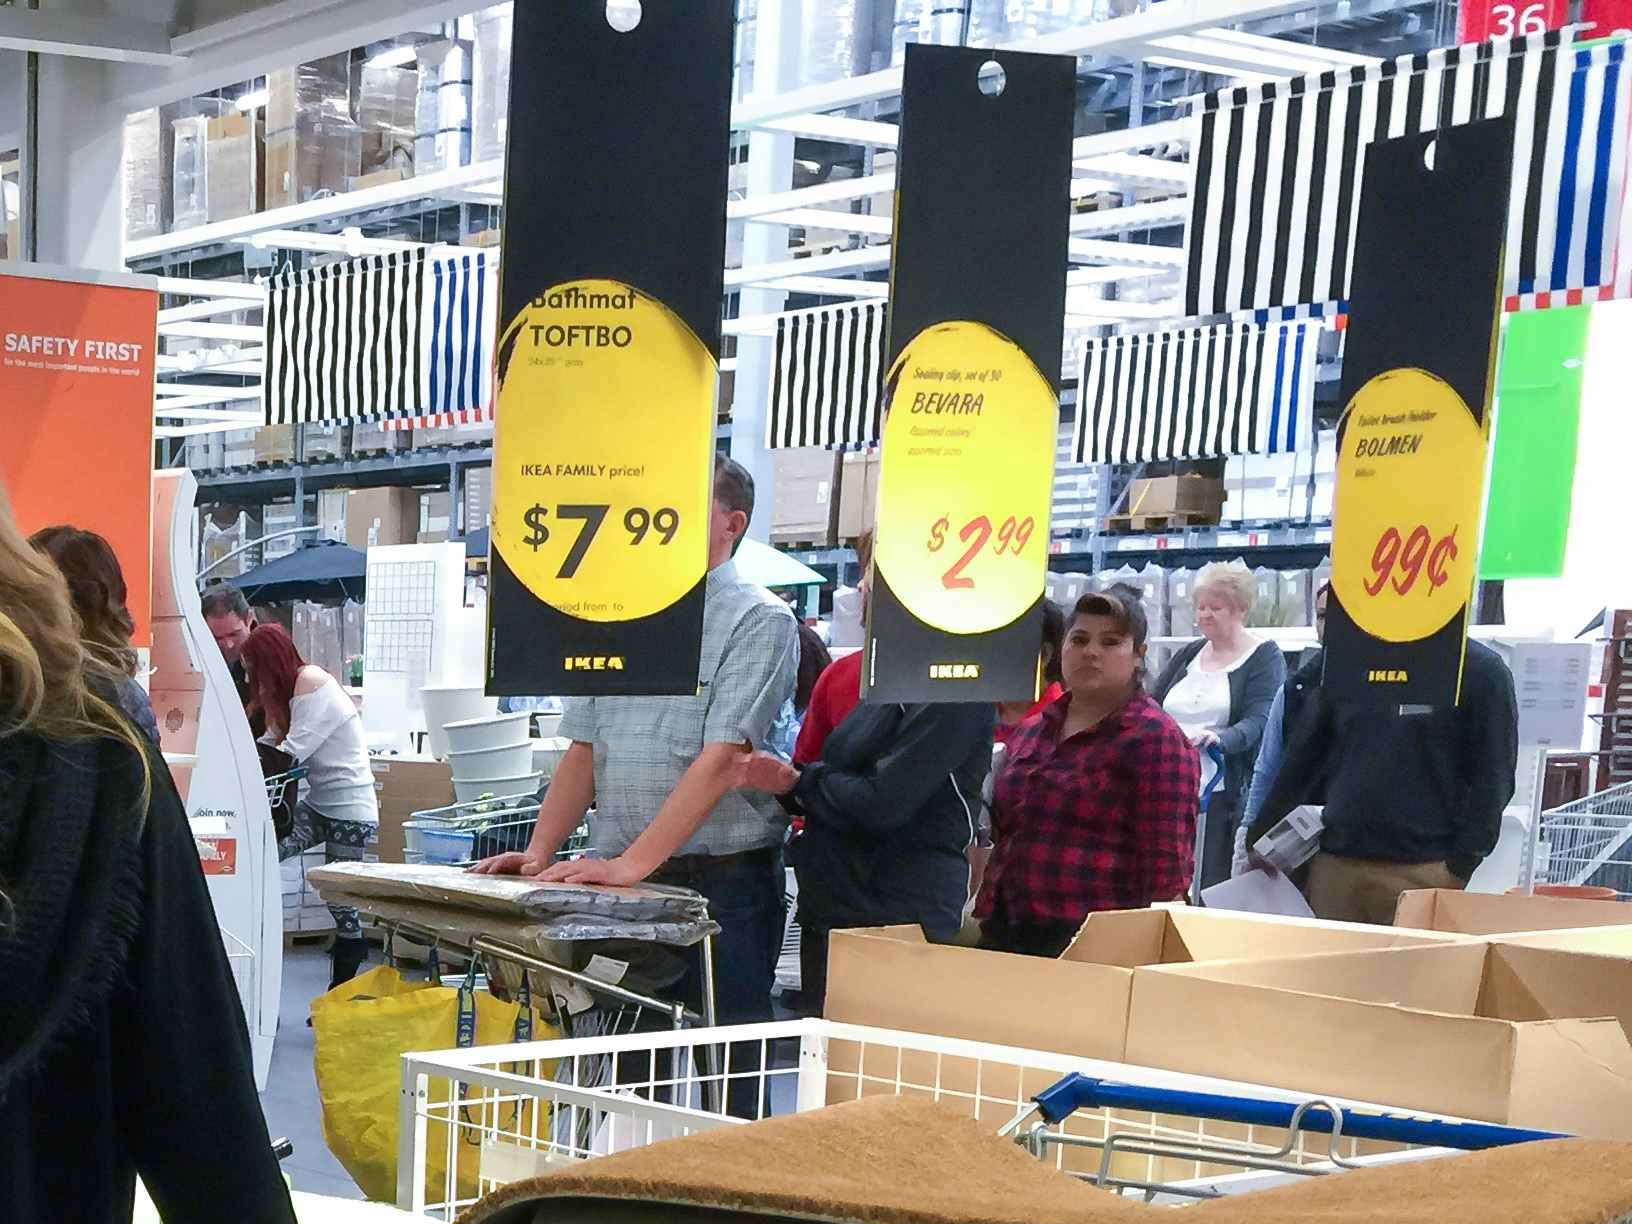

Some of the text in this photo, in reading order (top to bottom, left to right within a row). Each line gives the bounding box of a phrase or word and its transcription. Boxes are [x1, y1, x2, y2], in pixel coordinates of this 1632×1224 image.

[1492, 4, 1545, 40] 36
[4, 333, 143, 362] SAFETY FIRST
[529, 325, 632, 347] TOFTBO
[911, 392, 984, 416] BEVARA
[1355, 433, 1423, 459] BOLMEN
[521, 464, 645, 480] IKEA FAMILY price!
[1363, 524, 1458, 597] 99¢
[564, 656, 624, 671] IKEA
[929, 664, 979, 679] IKEA
[1368, 670, 1408, 682] IKEA
